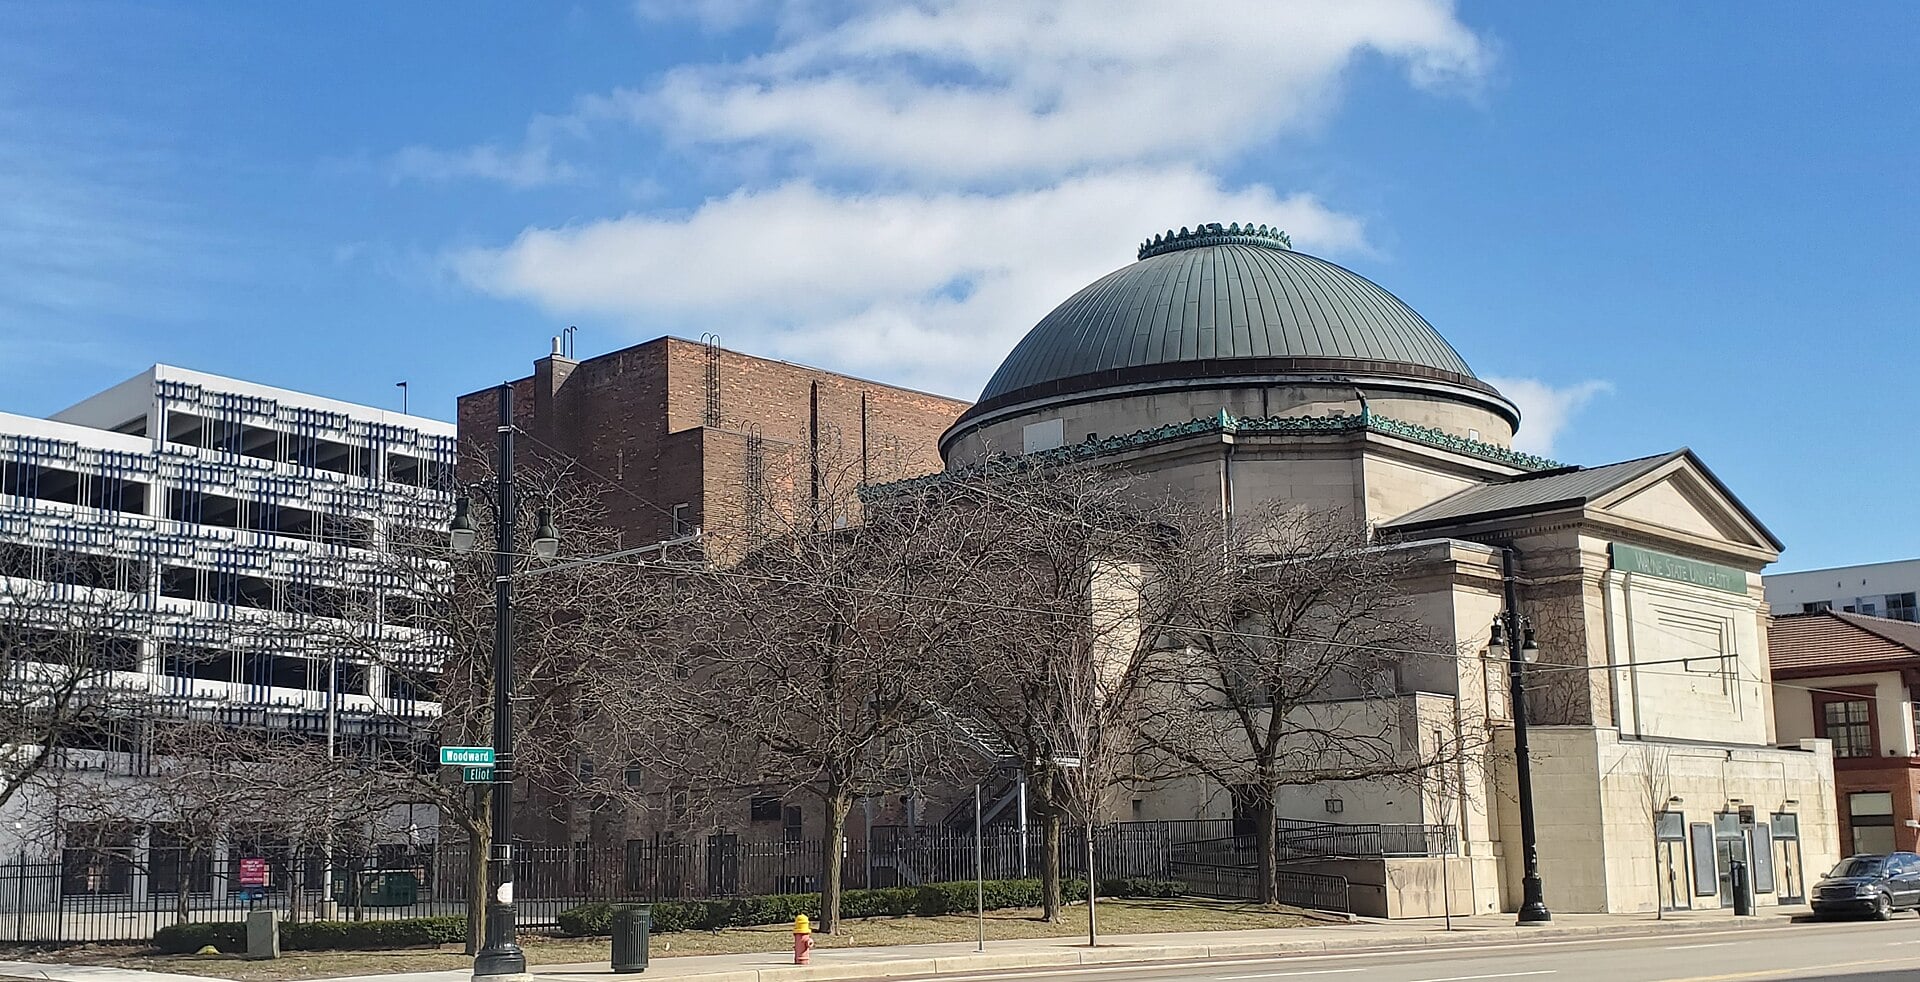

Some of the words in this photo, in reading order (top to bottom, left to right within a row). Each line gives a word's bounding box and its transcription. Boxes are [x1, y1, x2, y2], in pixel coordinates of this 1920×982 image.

[1666, 558, 1687, 579] STATE
[446, 750, 489, 762] Woodward
[470, 768, 490, 780] Eliot
